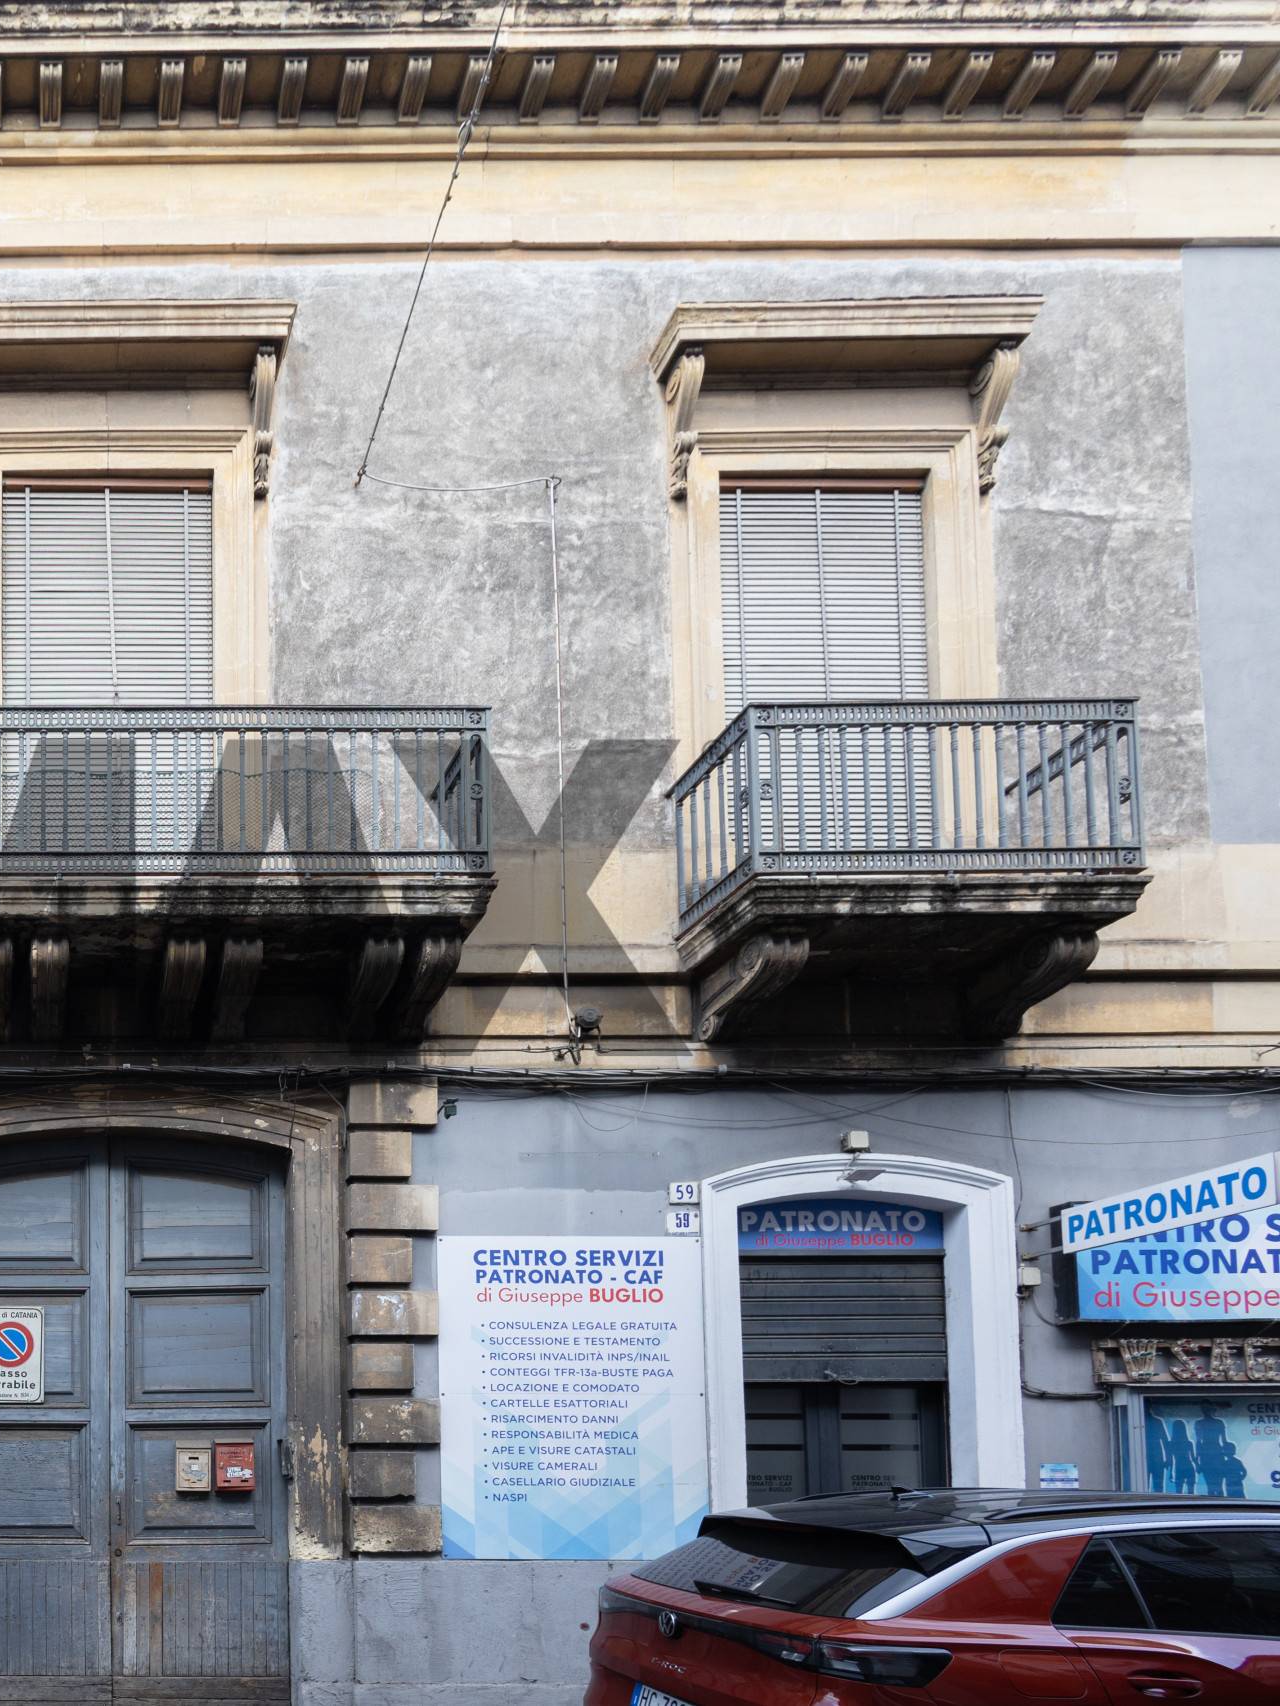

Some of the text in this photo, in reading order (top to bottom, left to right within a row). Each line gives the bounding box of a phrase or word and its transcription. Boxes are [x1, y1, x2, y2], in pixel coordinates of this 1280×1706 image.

[676, 1184, 694, 1200] 59
[1068, 1166, 1267, 1244] PATRONATO
[676, 1212, 690, 1228] 59
[741, 1210, 926, 1232] PATRONATO
[756, 1233, 914, 1249] di Giuseppe BUGLIO
[473, 1249, 664, 1267] CENTRO SERVIZI
[475, 1269, 603, 1284] PATRONATO
[624, 1270, 663, 1284] CAF
[476, 1287, 664, 1307] di Giuseppe BUGLIO
[1094, 1281, 1280, 1313] di Giuseppe
[489, 1321, 677, 1332] CONSULENZA LEGALE GRATUITA
[489, 1337, 661, 1347] SUCCESSIONE E TESTAMENTO
[490, 1350, 670, 1363] RICORSI INVALIDITÀ INPS/INAIL
[490, 1368, 551, 1377] CONTEGGI
[642, 1368, 674, 1378] PAGA
[490, 1384, 640, 1393] LOCAZIONE E COMODATO
[490, 1399, 628, 1408] CARTELLE ESATTORIALI
[491, 1415, 619, 1424] RISARCIMENTO DANNI
[491, 1430, 639, 1440] RESPONSABILITÀ MEDICA
[492, 1446, 636, 1455] APE E VISURE CATASTALI
[492, 1462, 598, 1471] VISURE CAMERALI
[492, 1477, 635, 1487] CASELLARIO GIUDIZIALE
[493, 1493, 528, 1502] NASPI
